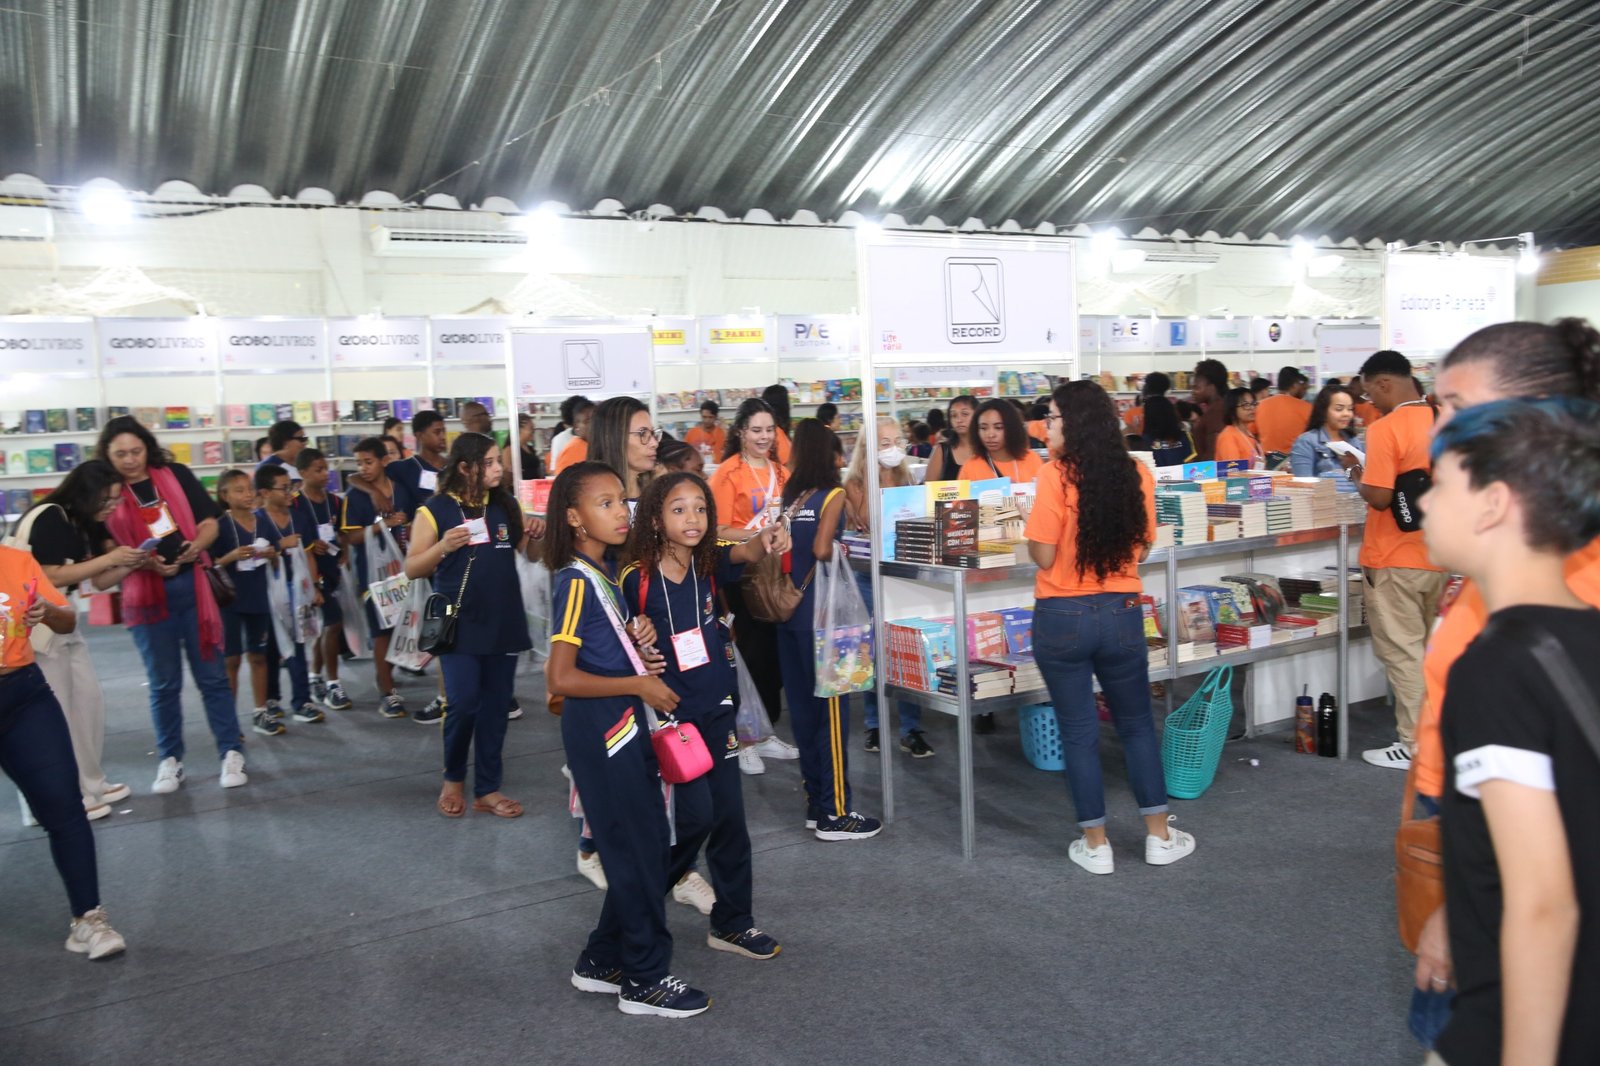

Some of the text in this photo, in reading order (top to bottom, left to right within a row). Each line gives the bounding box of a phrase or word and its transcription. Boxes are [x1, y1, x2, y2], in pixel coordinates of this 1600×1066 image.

[725, 330, 762, 338] PANINI
[952, 327, 1001, 338] RECORD
[567, 379, 602, 387] RECORD
[1398, 491, 1412, 523] adidas
